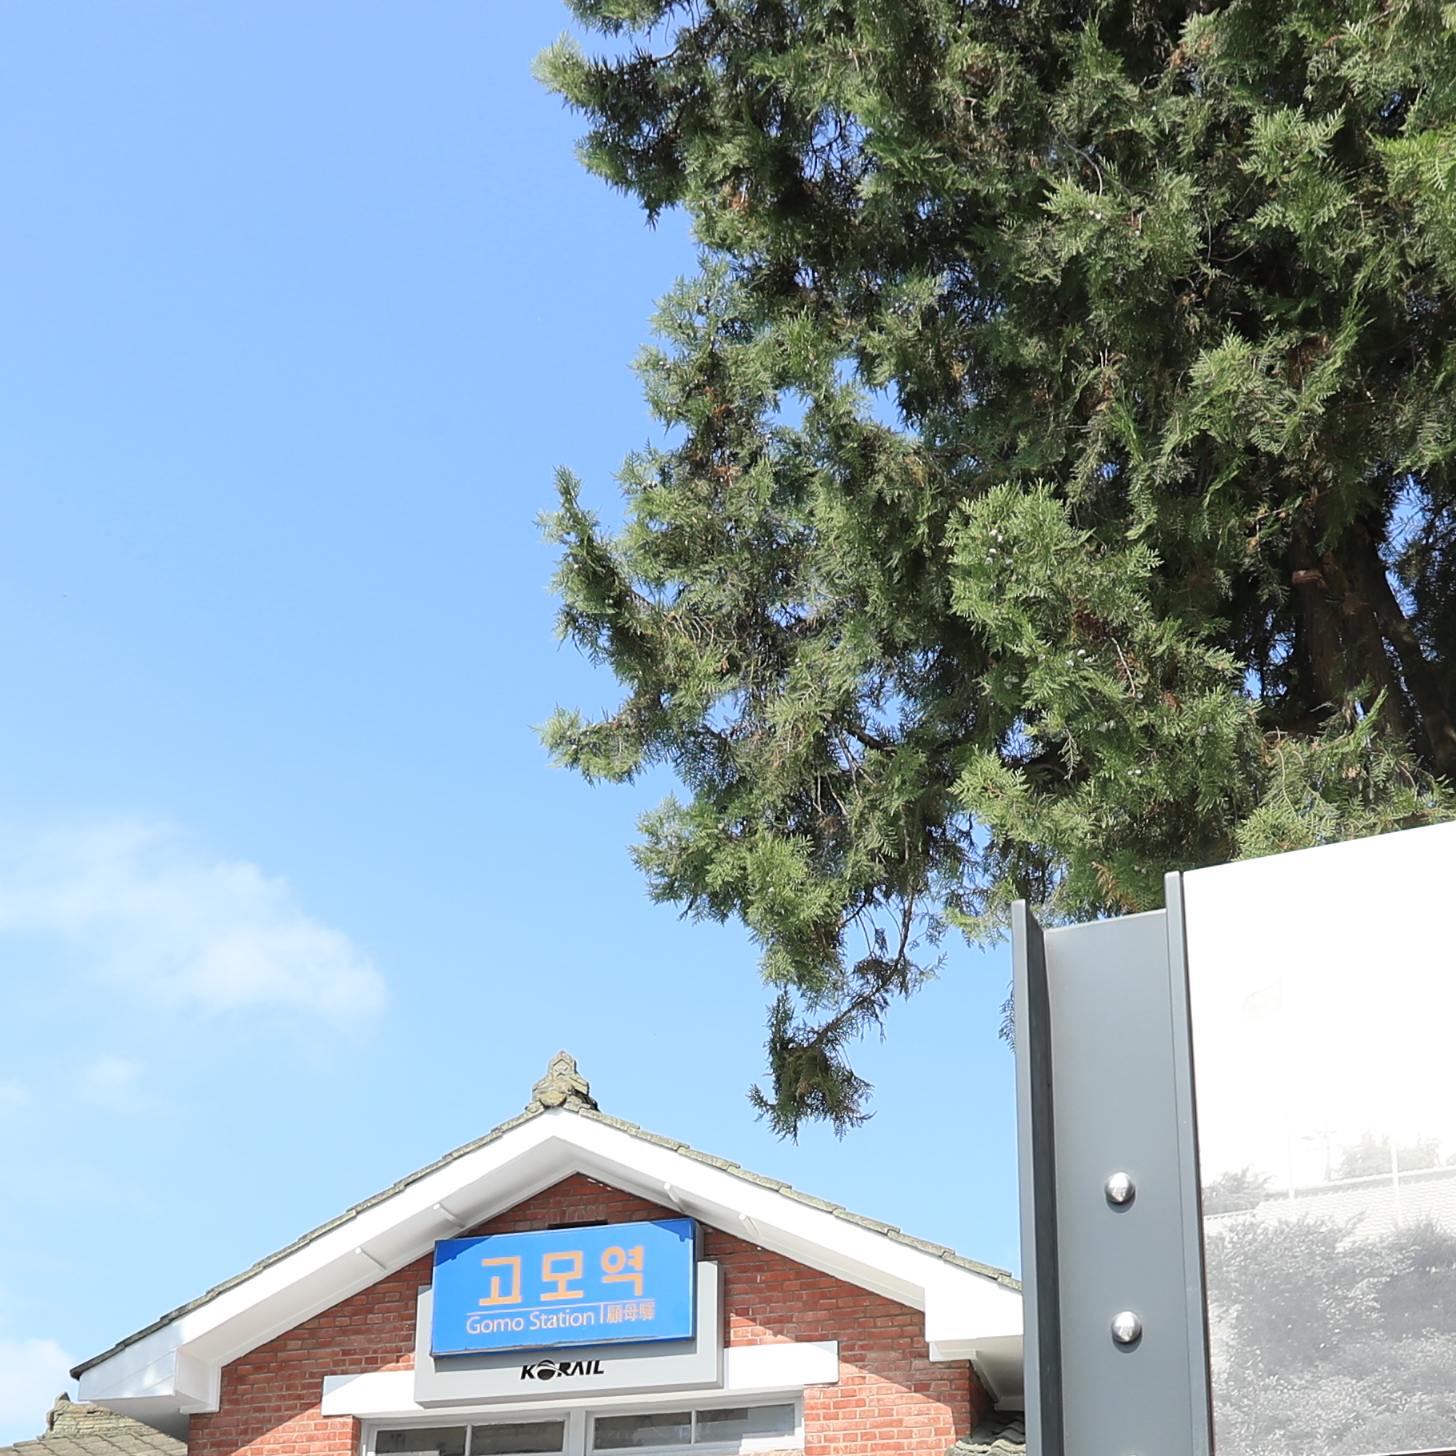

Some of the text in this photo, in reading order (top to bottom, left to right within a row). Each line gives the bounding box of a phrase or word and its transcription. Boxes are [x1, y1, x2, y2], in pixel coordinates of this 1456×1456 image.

[478, 1245, 644, 1306] 고모역
[466, 1315, 524, 1335] Gomo
[529, 1309, 594, 1331] Station
[520, 1359, 605, 1381] KORAIL
